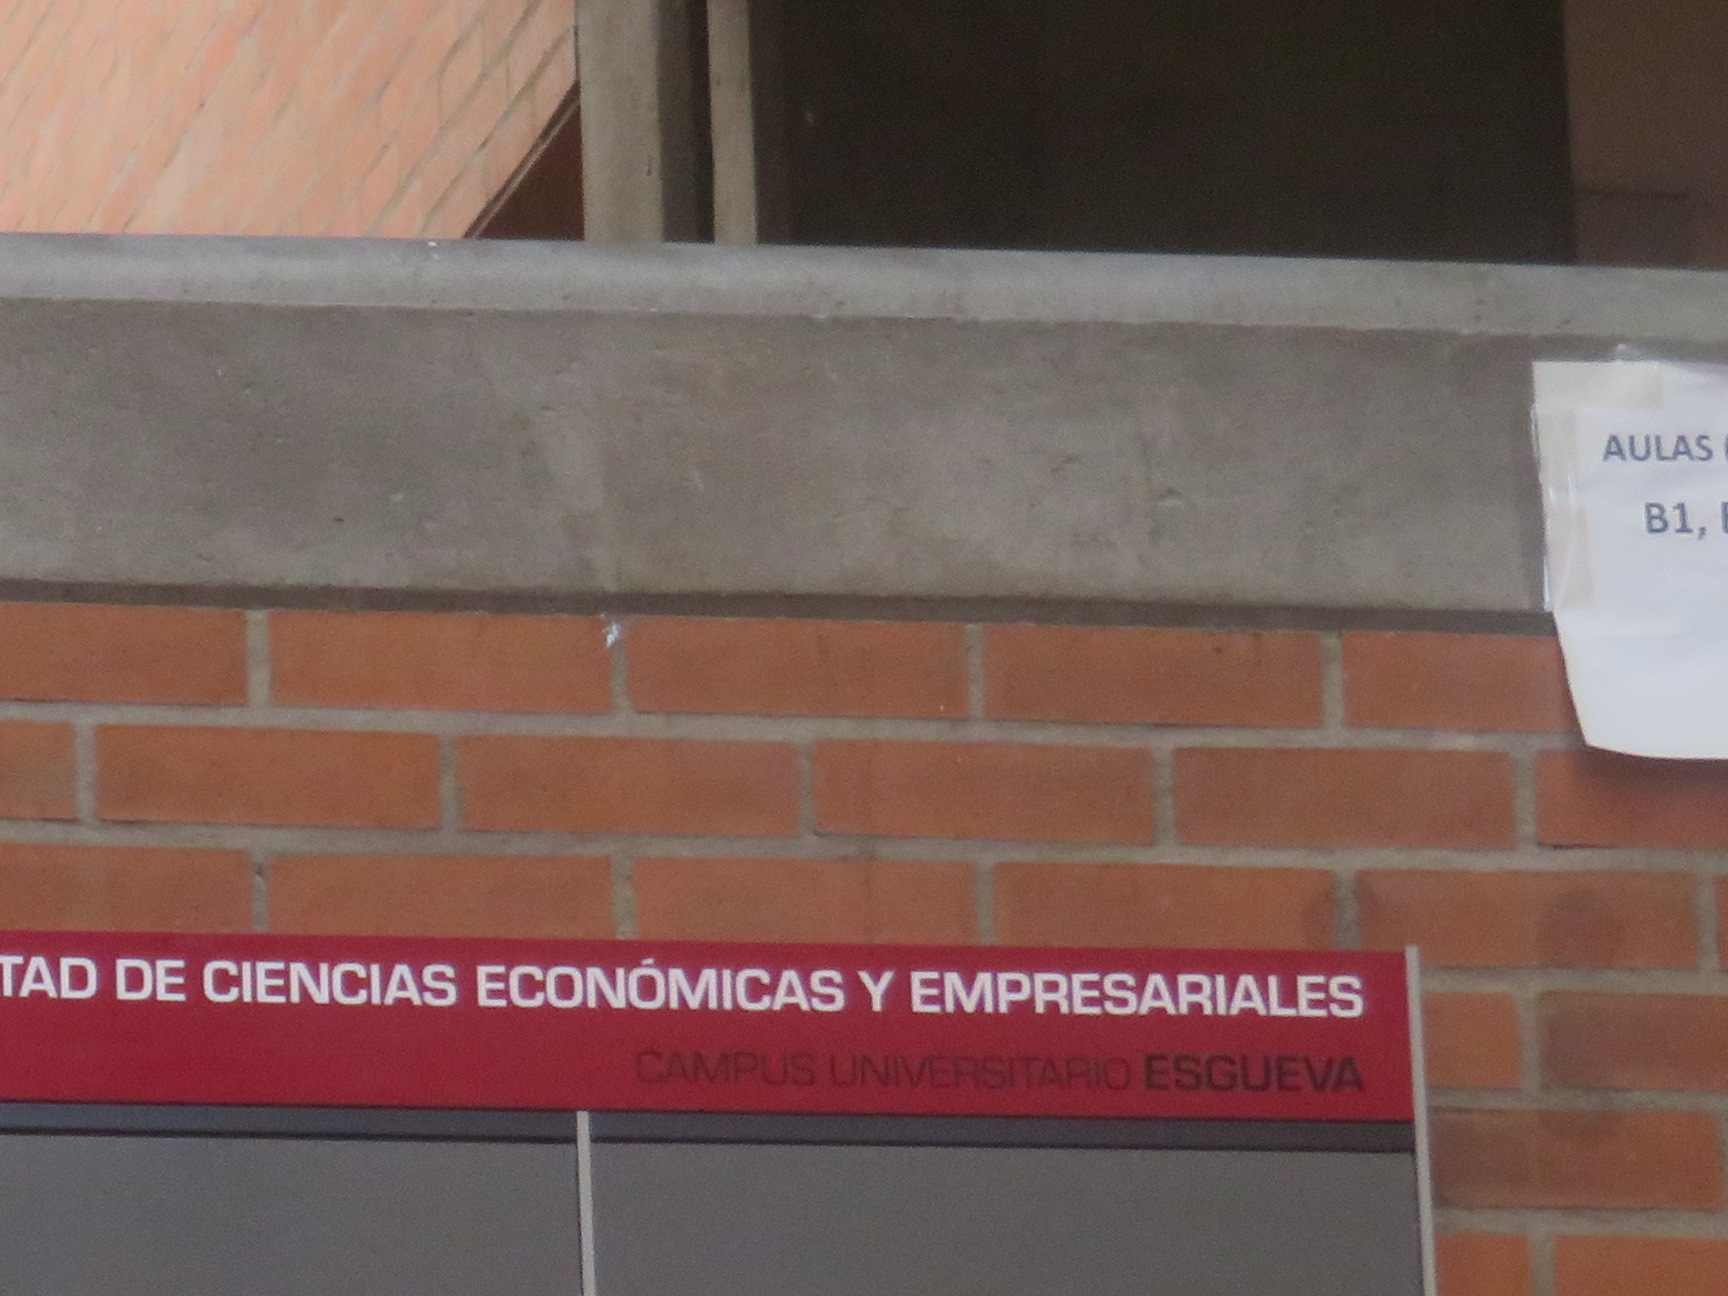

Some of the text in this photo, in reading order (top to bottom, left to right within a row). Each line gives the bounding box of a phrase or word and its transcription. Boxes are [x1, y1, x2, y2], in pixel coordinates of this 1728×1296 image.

[1603, 435, 1714, 462] AULAS
[1645, 502, 1707, 540] B1,
[115, 957, 187, 1002] DE
[202, 959, 458, 1007] CIENCIAS
[476, 955, 845, 1012] ECONÓMICAS
[858, 970, 895, 1013] Y
[910, 970, 1364, 1018] EMPRESARIALES
[635, 1048, 1366, 1093] CAMPUS UNIVERSITARIO ESGUEVA
